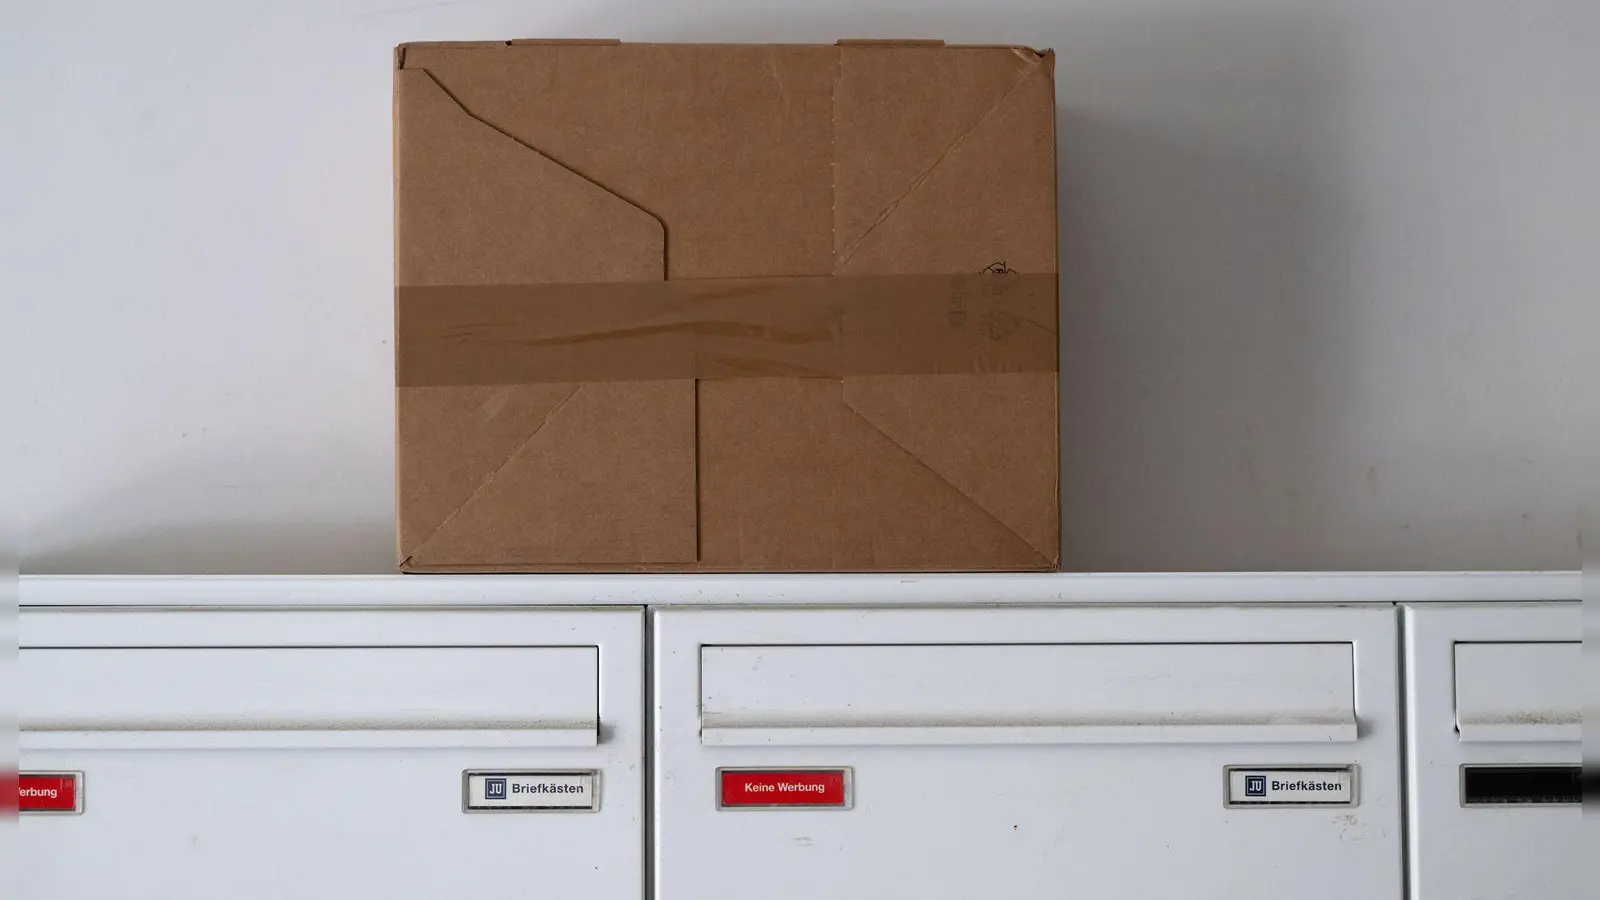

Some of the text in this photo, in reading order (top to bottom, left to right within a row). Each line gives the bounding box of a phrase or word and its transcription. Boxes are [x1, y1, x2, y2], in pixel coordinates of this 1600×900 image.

[489, 783, 584, 794] JU Briefkästen
[744, 782, 825, 794] Keine Werbung
[1249, 780, 1342, 791] JU Briefkästen
[19, 787, 57, 799] erbung
